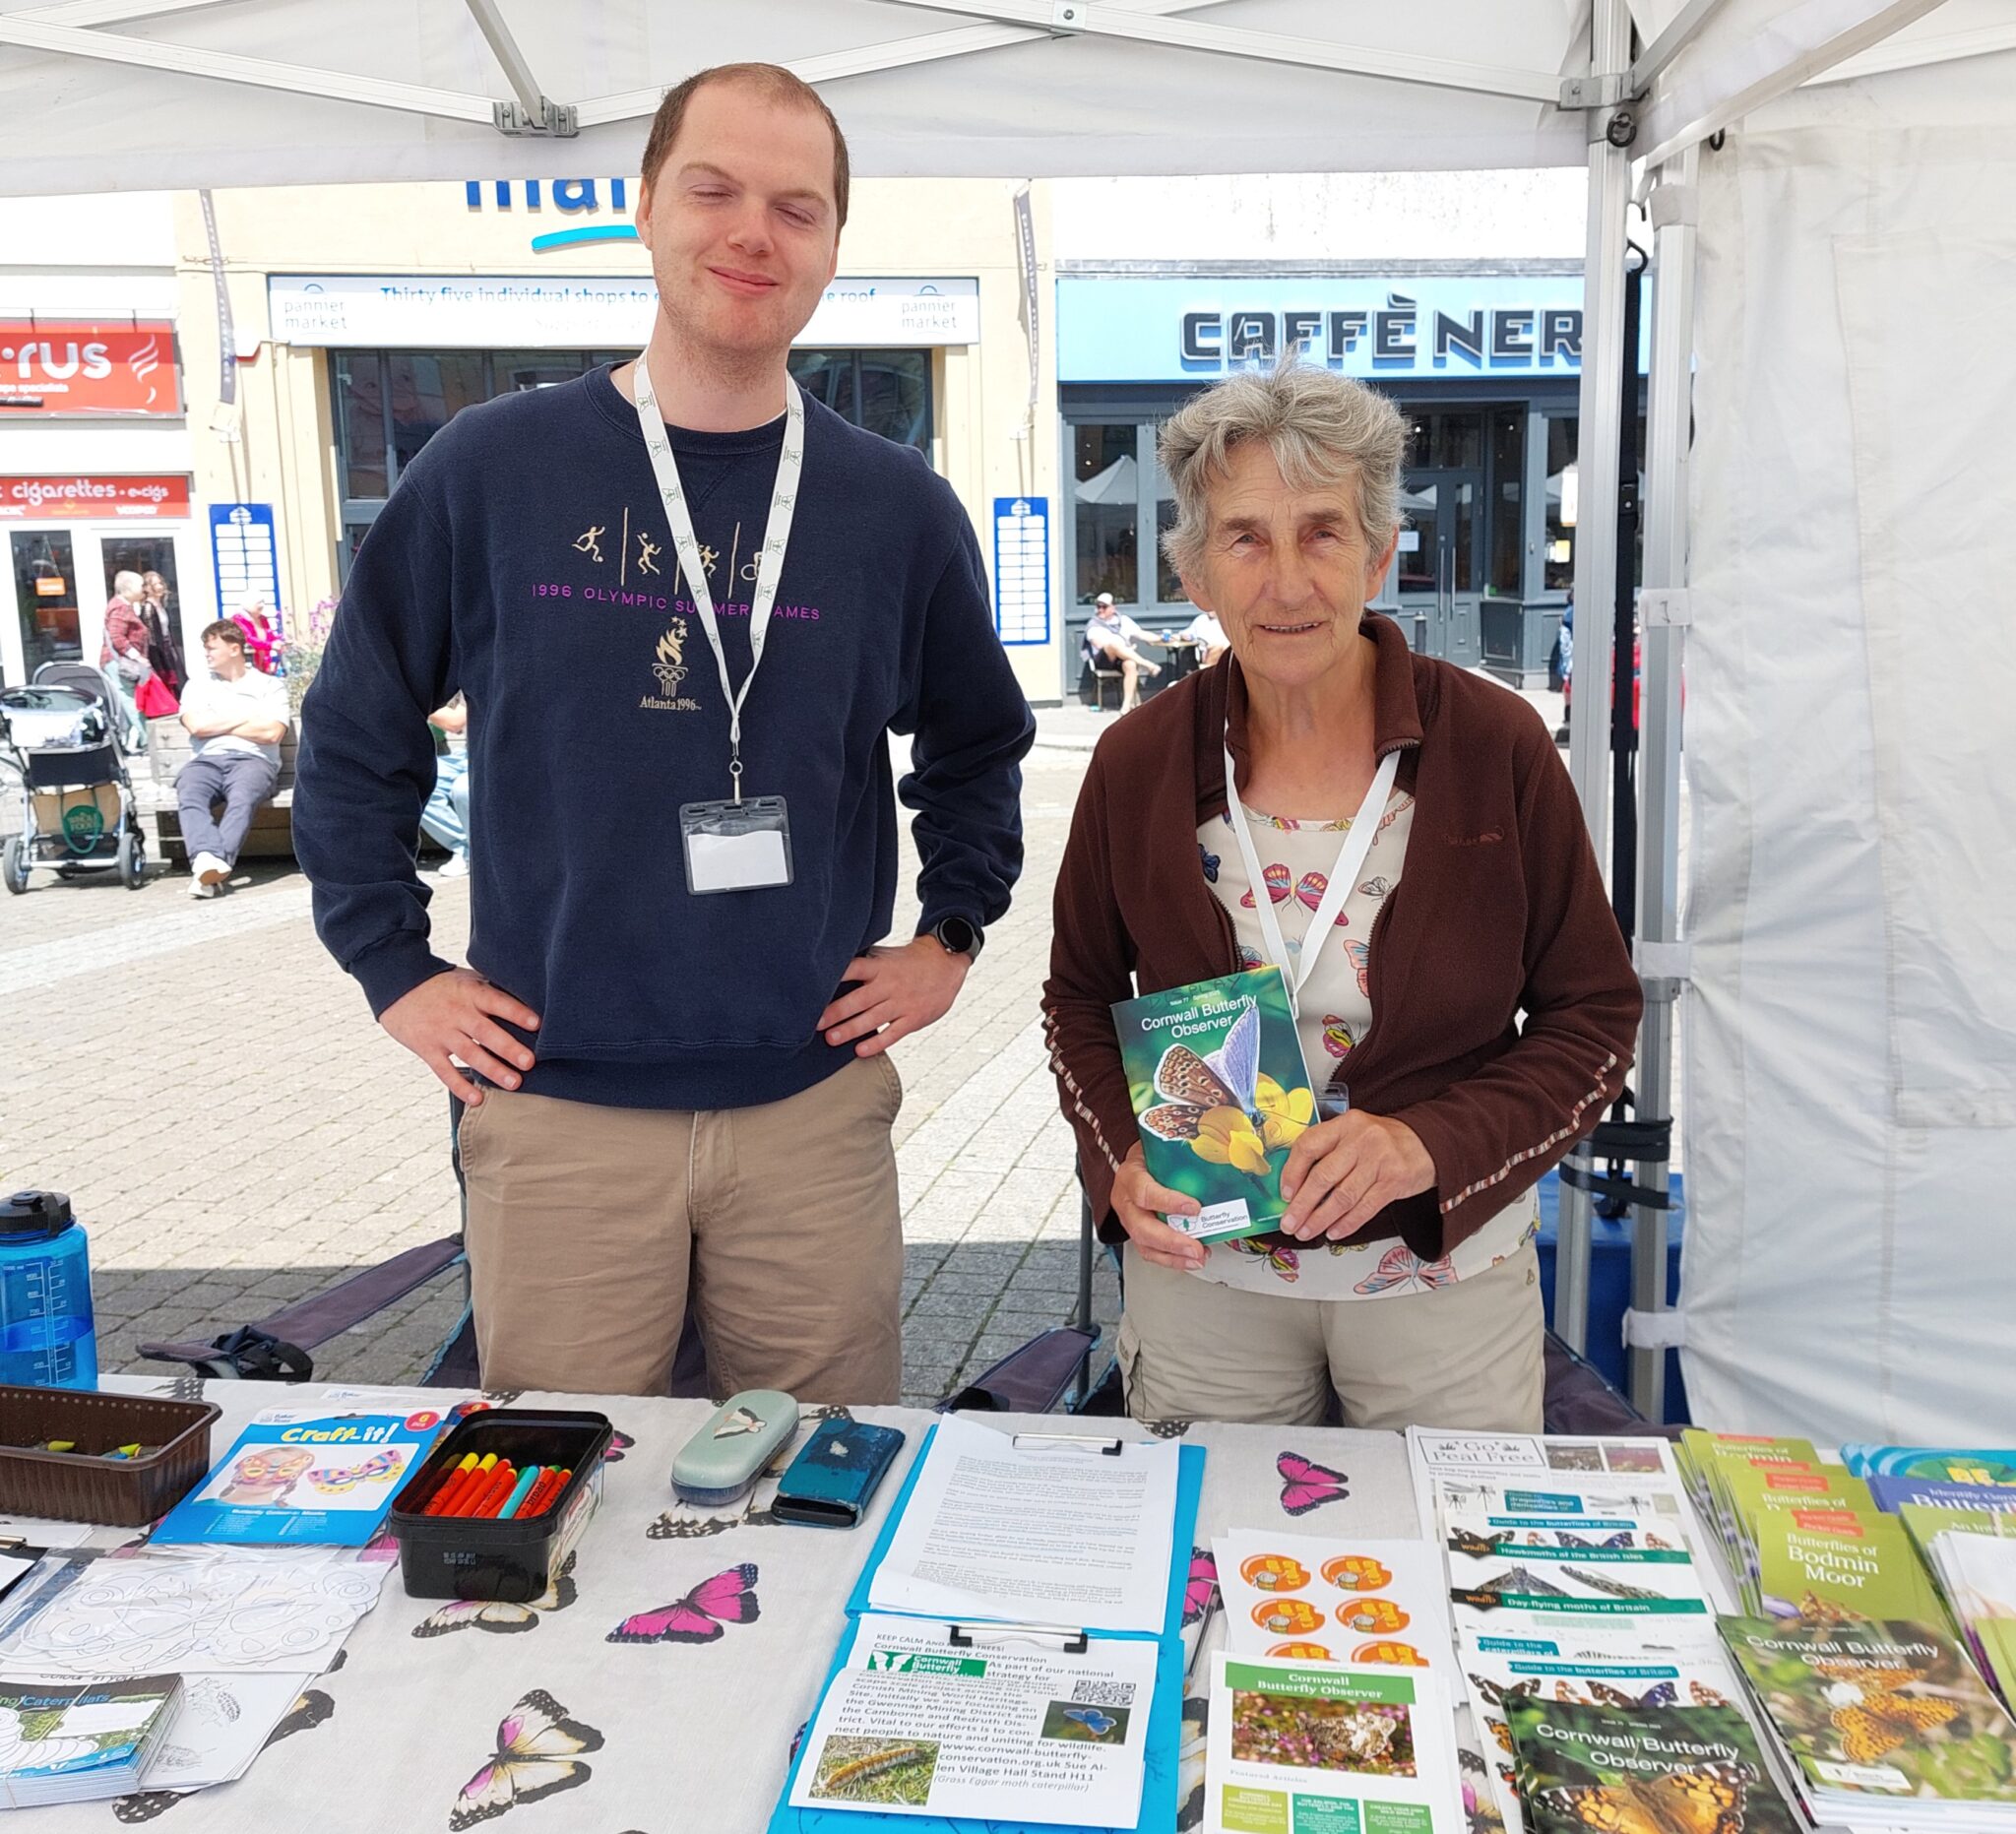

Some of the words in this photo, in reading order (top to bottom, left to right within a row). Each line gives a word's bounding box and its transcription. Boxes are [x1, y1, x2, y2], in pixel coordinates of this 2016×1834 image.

[380, 286, 435, 305] Thirty
[441, 286, 472, 302] five
[478, 288, 569, 303] individual
[574, 288, 626, 306] shops
[630, 289, 649, 302] to
[841, 287, 876, 302] roof
[284, 298, 345, 314] pannier
[902, 299, 956, 314] pannier
[284, 314, 347, 329] market
[902, 315, 958, 329] market
[1181, 291, 1418, 362] CAFFÈ
[12, 479, 116, 506] cigarettes
[128, 485, 168, 502] e-cigs
[532, 584, 572, 599] 1996
[584, 588, 667, 610] OLYMPIC
[675, 601, 749, 617] SUMER
[773, 605, 821, 620] AMES
[1142, 1007, 1198, 1031] Cornwall
[1202, 994, 1257, 1017] Butterfly
[1171, 1015, 1233, 1039] Observer
[1201, 1212, 1230, 1223] Butterfly
[281, 1423, 401, 1444] Craft-it!
[1464, 1441, 1495, 1452] Go
[1433, 1451, 1480, 1462] Peat
[1486, 1452, 1534, 1463] Free
[1787, 1533, 1859, 1553] Butterflies
[1862, 1546, 1877, 1557] of
[1500, 1548, 1556, 1558] Hawkmoths
[1590, 1551, 1620, 1561] British
[1622, 1552, 1644, 1561] Isles
[1789, 1545, 1879, 1574] Bodmin
[1805, 1563, 1865, 1588] Moor
[1564, 1602, 1598, 1611] moths
[1600, 1602, 1611, 1612] of
[1613, 1604, 1651, 1613] Britain
[900, 1635, 923, 1644] CALM
[1746, 1635, 1842, 1654] Cornwall
[1846, 1641, 1939, 1659] Butterfly
[874, 1642, 922, 1652] Cornwall
[925, 1647, 973, 1658] Butterfly
[975, 1652, 1047, 1664] Conservation
[914, 1655, 962, 1667] Cornwall
[1800, 1653, 1902, 1670] Observer
[913, 1662, 961, 1674] Butterfly
[986, 1671, 1032, 1680] strategy
[1004, 1664, 1028, 1673] part
[1068, 1669, 1114, 1677] national
[1514, 1663, 1542, 1673] Guide
[1575, 1666, 1625, 1676] butterflies
[1640, 1668, 1673, 1676] Britain
[1257, 1679, 1317, 1695] Butterfly
[1321, 1685, 1383, 1699] Observer
[1289, 1674, 1350, 1686] Cornwall
[852, 1683, 895, 1693] Cornish
[899, 1686, 938, 1697] Mining
[978, 1695, 1029, 1705] Heritage
[877, 1692, 919, 1702] Initially
[965, 1700, 1019, 1713] focussing
[864, 1708, 924, 1719] Camborne
[953, 1715, 1000, 1726] Redruth
[867, 1699, 922, 1711] Gwennap
[926, 1705, 967, 1714] Mining
[970, 1708, 1012, 1718] District
[1015, 1712, 1038, 1721] and
[870, 1717, 897, 1726] Vital
[938, 1723, 976, 1732] efforts
[863, 1728, 904, 1738] people
[992, 1737, 1034, 1747] uniting
[1058, 1741, 1106, 1752] wildlife.
[1537, 1724, 1637, 1749] Cornwall
[1643, 1737, 1738, 1760] Butterfly
[939, 1753, 1062, 1768] conservation.org.uk
[1064, 1761, 1088, 1771] Sue
[1590, 1751, 1695, 1774] Observer
[936, 1763, 956, 1773] len
[959, 1765, 1000, 1777] Village
[1003, 1768, 1028, 1777] Hall
[1031, 1770, 1067, 1780] Stand
[1070, 1773, 1095, 1782] H11
[934, 1774, 967, 1785] (Grass
[1001, 1779, 1029, 1789] moth
[1032, 1781, 1090, 1794] caterpillar)
